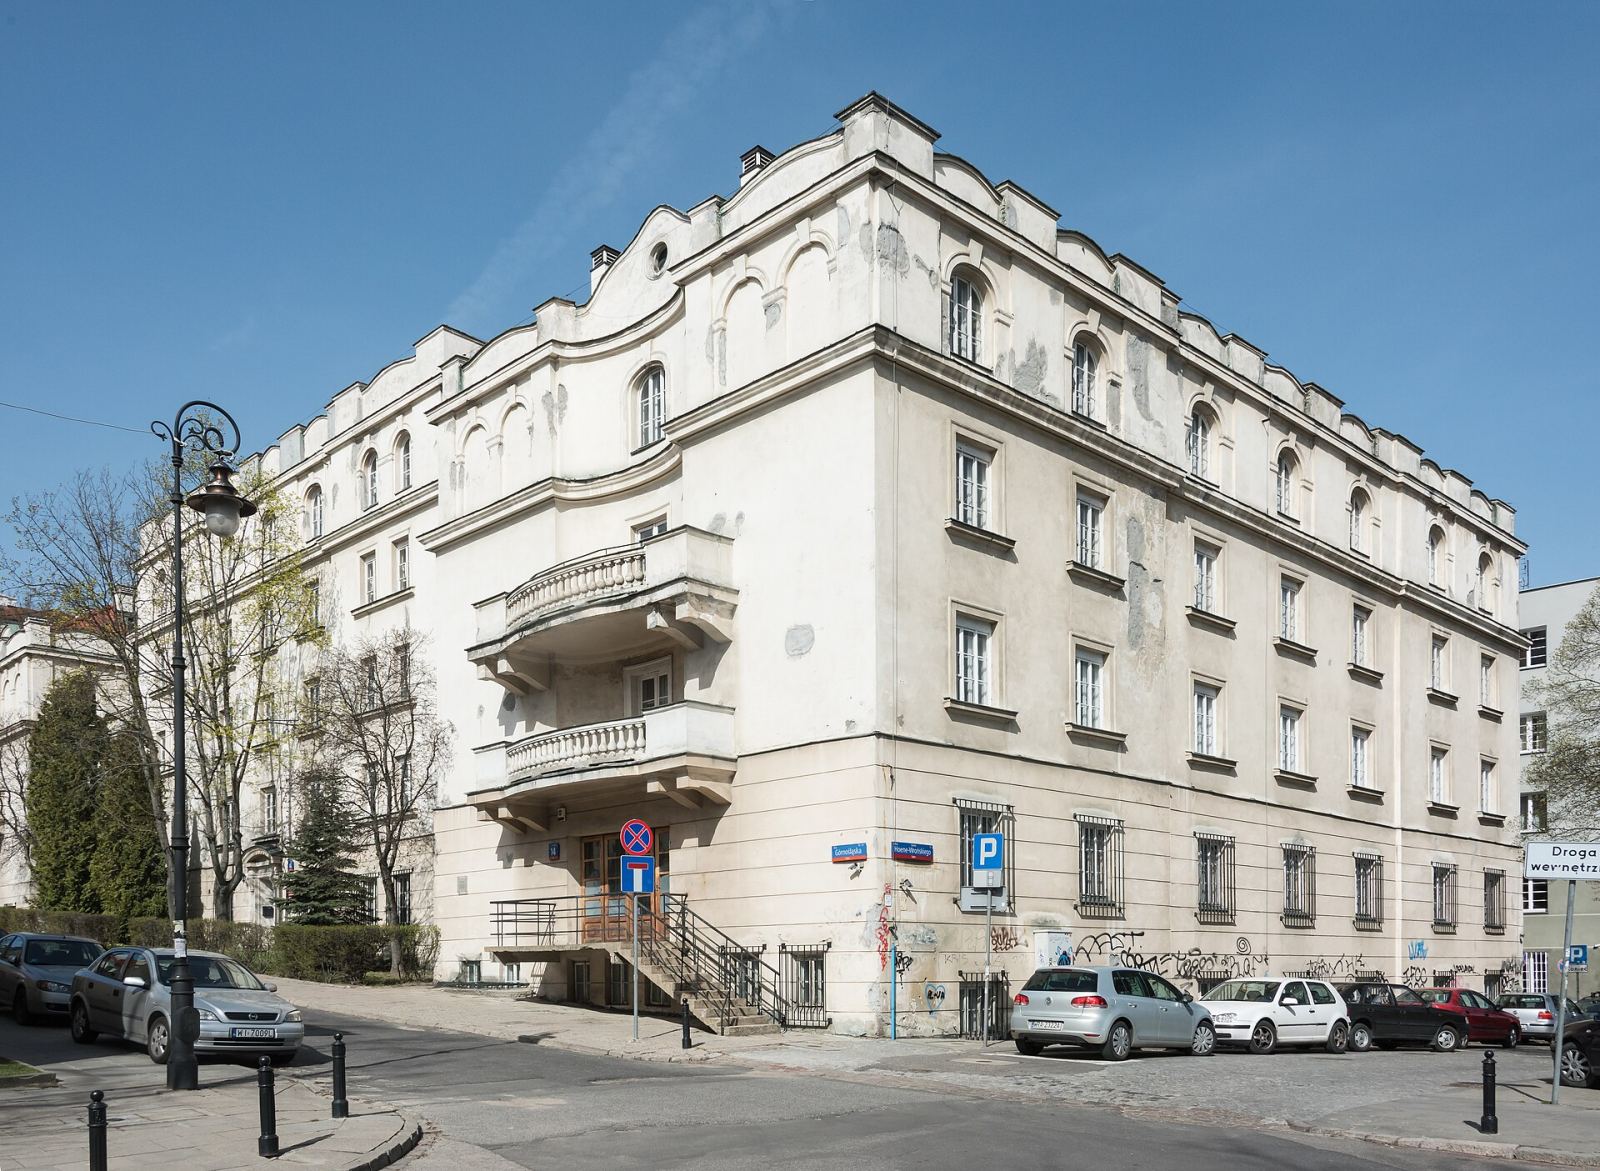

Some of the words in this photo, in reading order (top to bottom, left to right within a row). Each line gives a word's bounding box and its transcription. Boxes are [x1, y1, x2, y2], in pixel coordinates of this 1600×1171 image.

[834, 848, 862, 857] Górnośląska
[980, 838, 997, 865] P
[1552, 846, 1597, 860] Droga
[1531, 863, 1600, 875] wewnętrz
[1571, 947, 1583, 962] P
